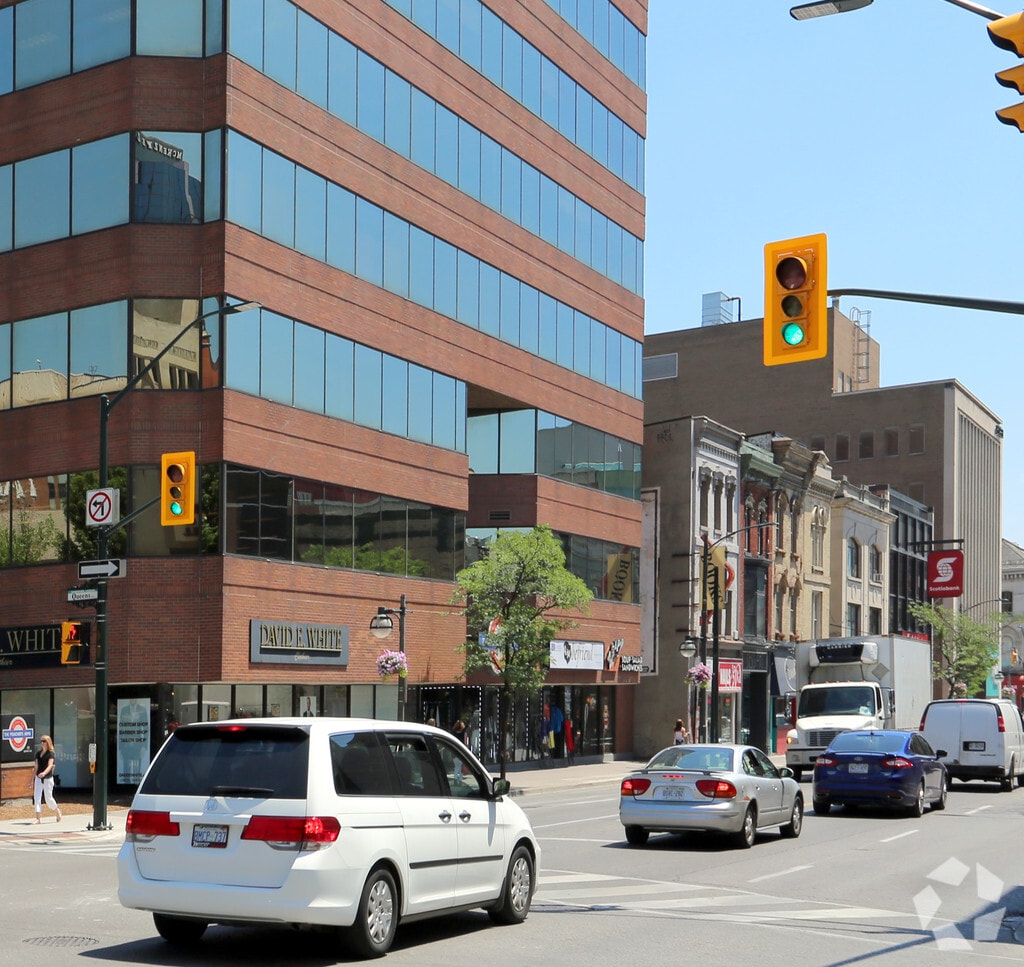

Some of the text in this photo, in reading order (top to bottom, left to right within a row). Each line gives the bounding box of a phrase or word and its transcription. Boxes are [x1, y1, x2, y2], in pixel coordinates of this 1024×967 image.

[7, 628, 62, 652] WHIT
[260, 624, 343, 650] DAVID E. WHITE
